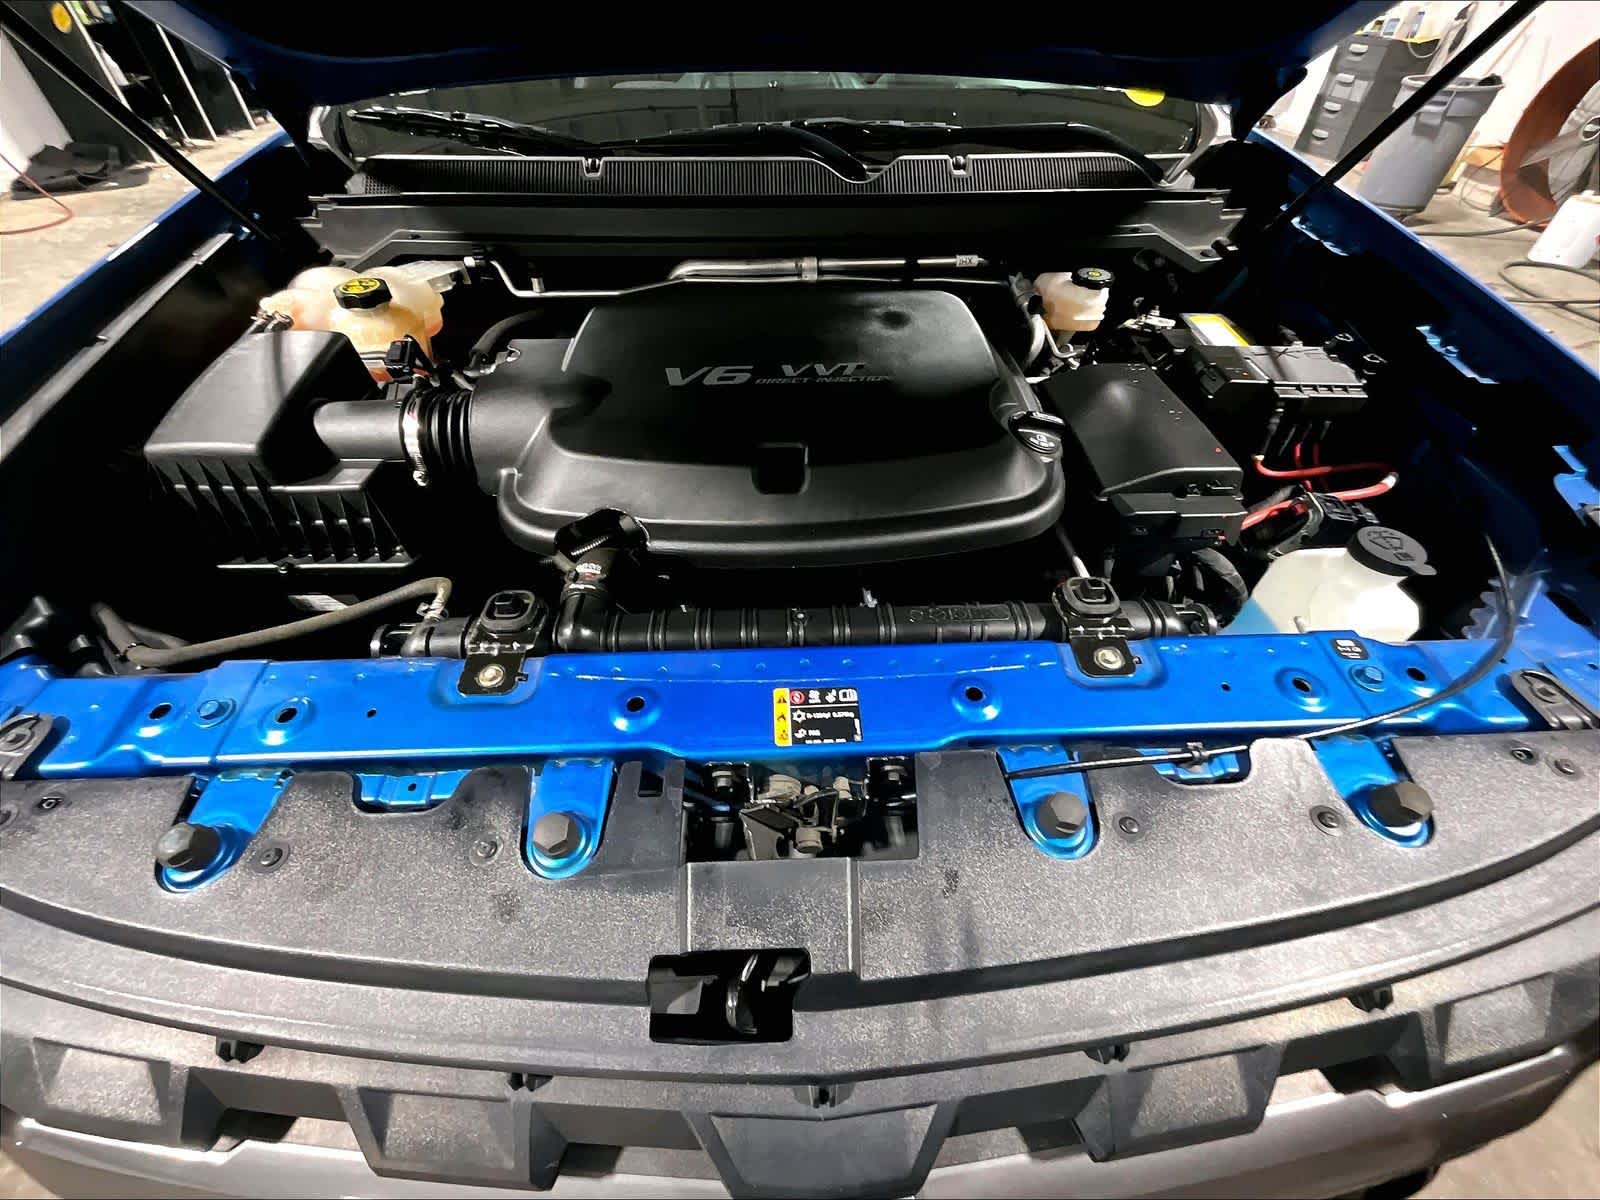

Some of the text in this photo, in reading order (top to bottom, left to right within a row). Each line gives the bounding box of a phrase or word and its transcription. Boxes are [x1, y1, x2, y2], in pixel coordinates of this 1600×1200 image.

[665, 362, 867, 386] V6 VVT
[816, 375, 894, 383] INJECTION
